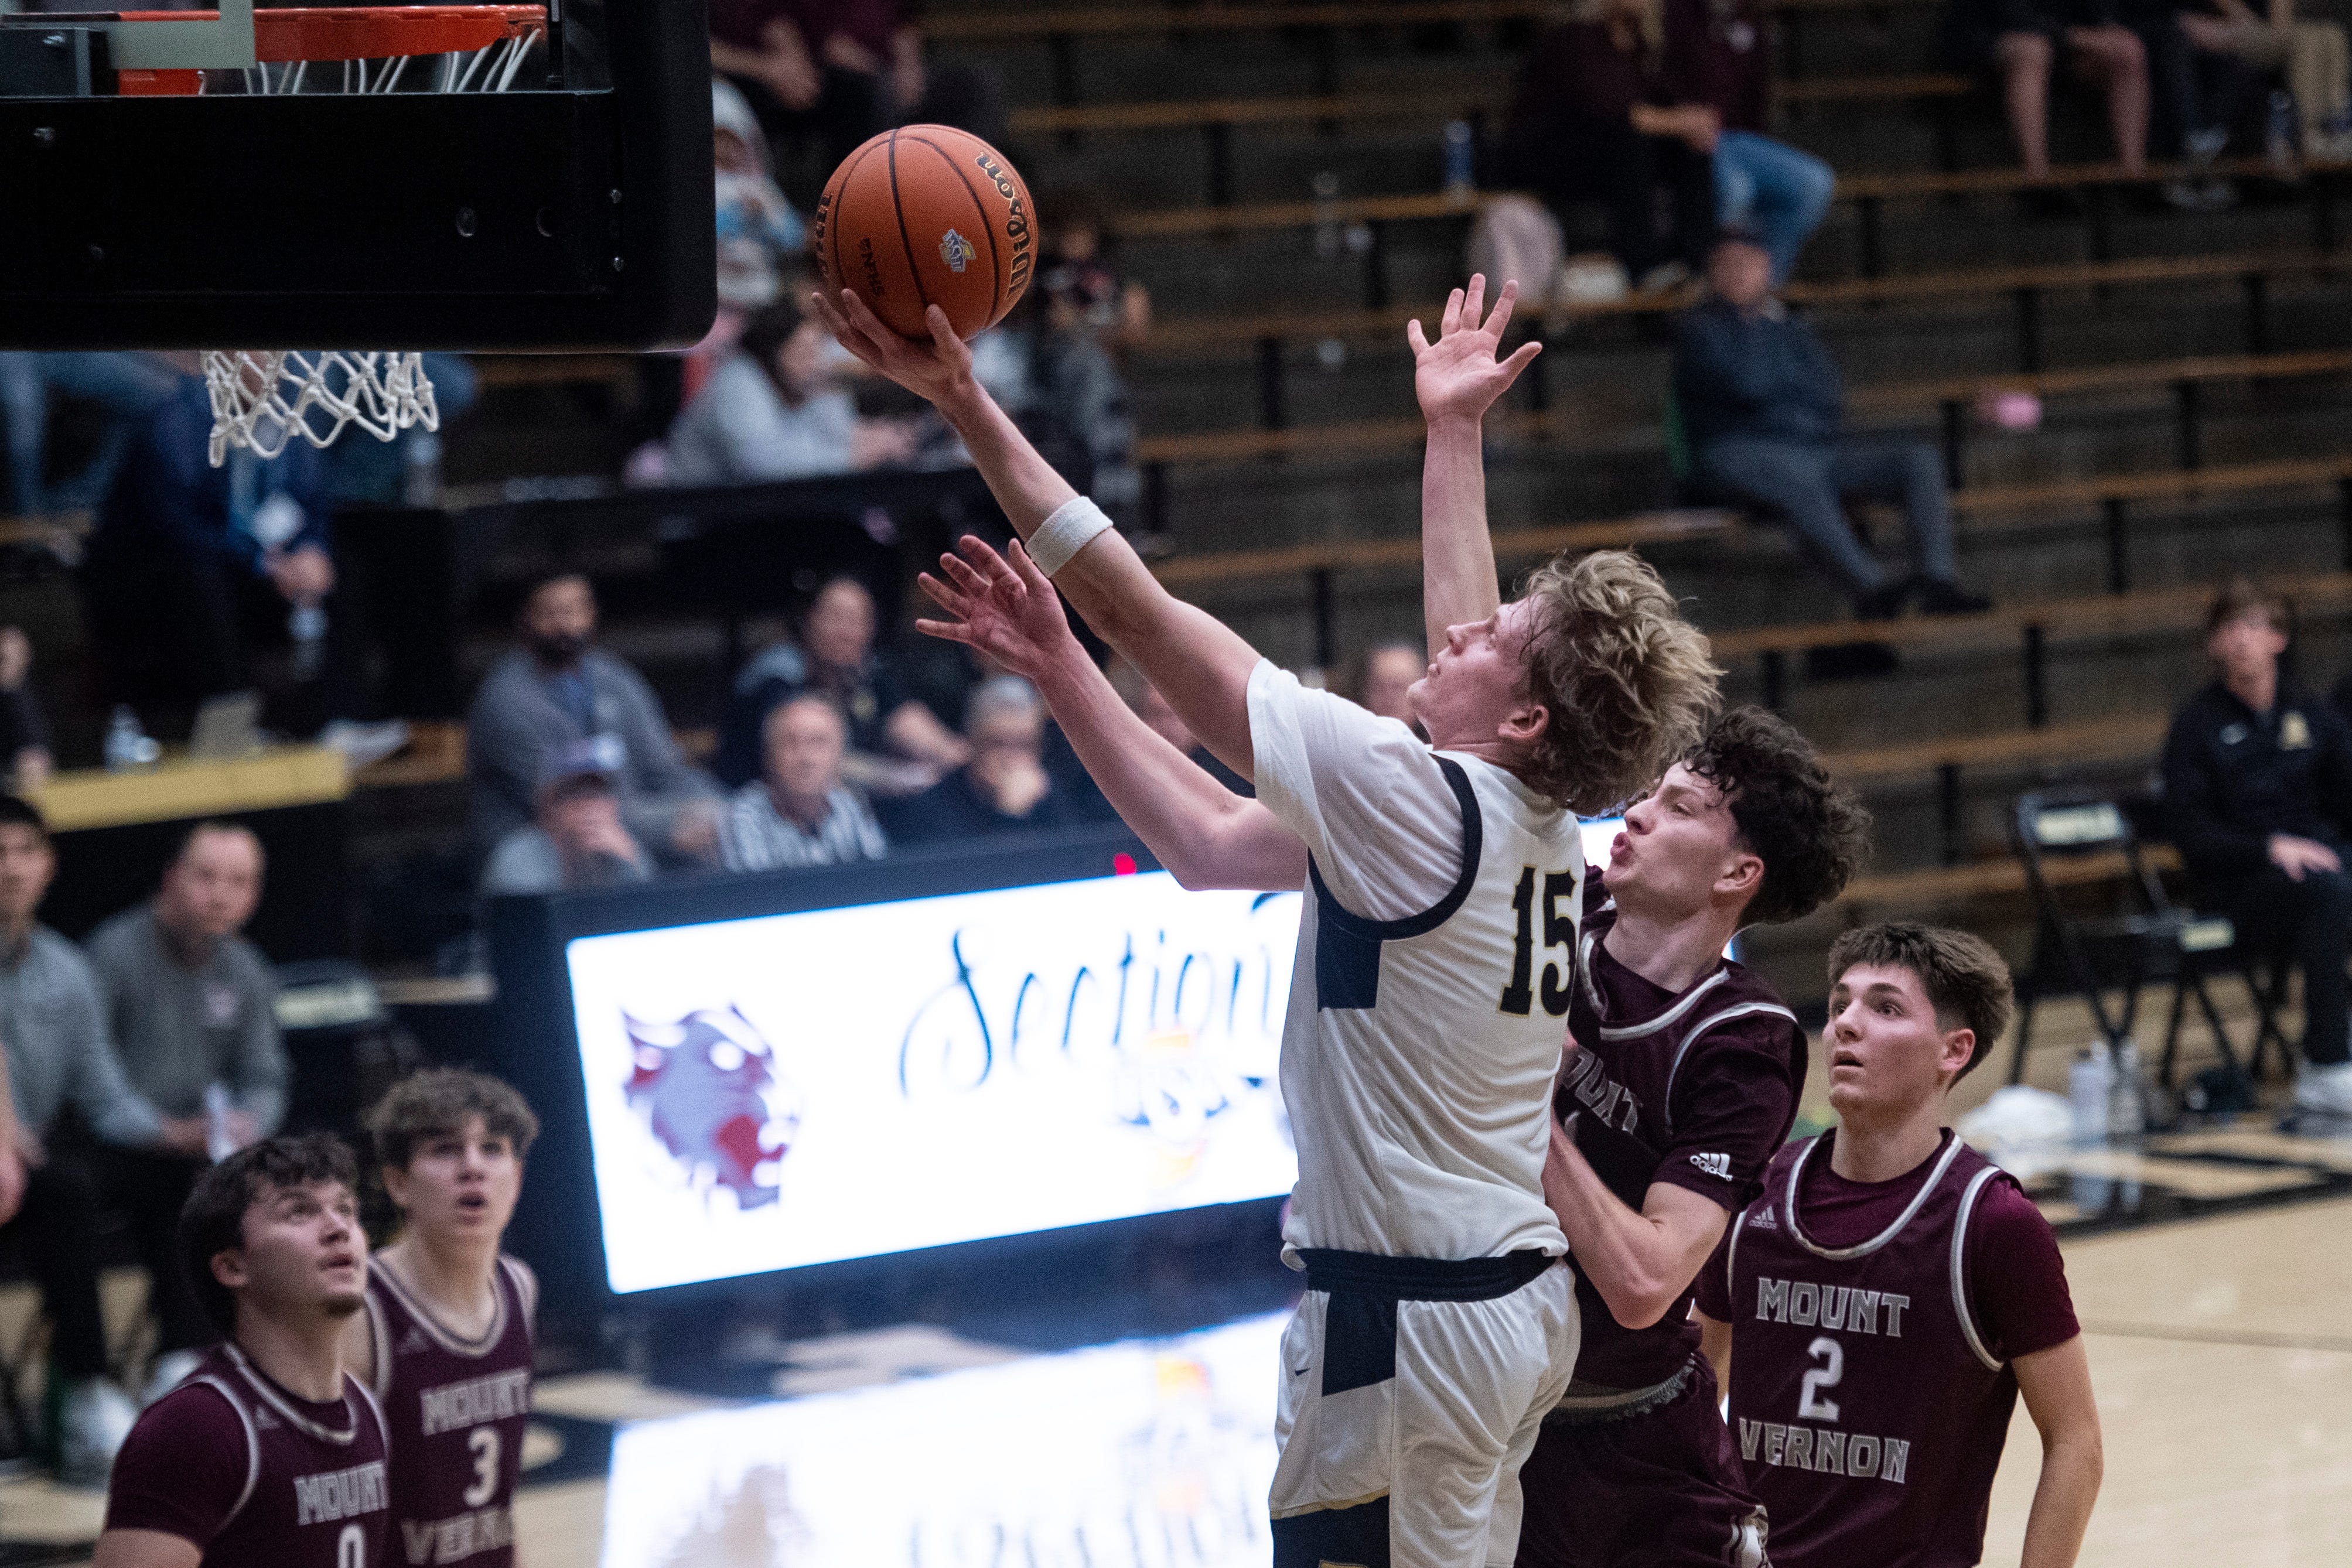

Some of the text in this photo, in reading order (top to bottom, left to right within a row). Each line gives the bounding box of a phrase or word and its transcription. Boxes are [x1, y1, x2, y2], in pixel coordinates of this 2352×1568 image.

[975, 152, 1031, 300] Wilson
[1498, 865, 1577, 1017] 15
[1756, 1277, 1910, 1337] MOUNT
[419, 1366, 528, 1436] MOUNT
[1798, 1337, 1844, 1422] 2
[464, 1426, 502, 1506] 3
[1739, 1417, 1910, 1484] VERNON
[294, 1460, 389, 1525] MOUNT
